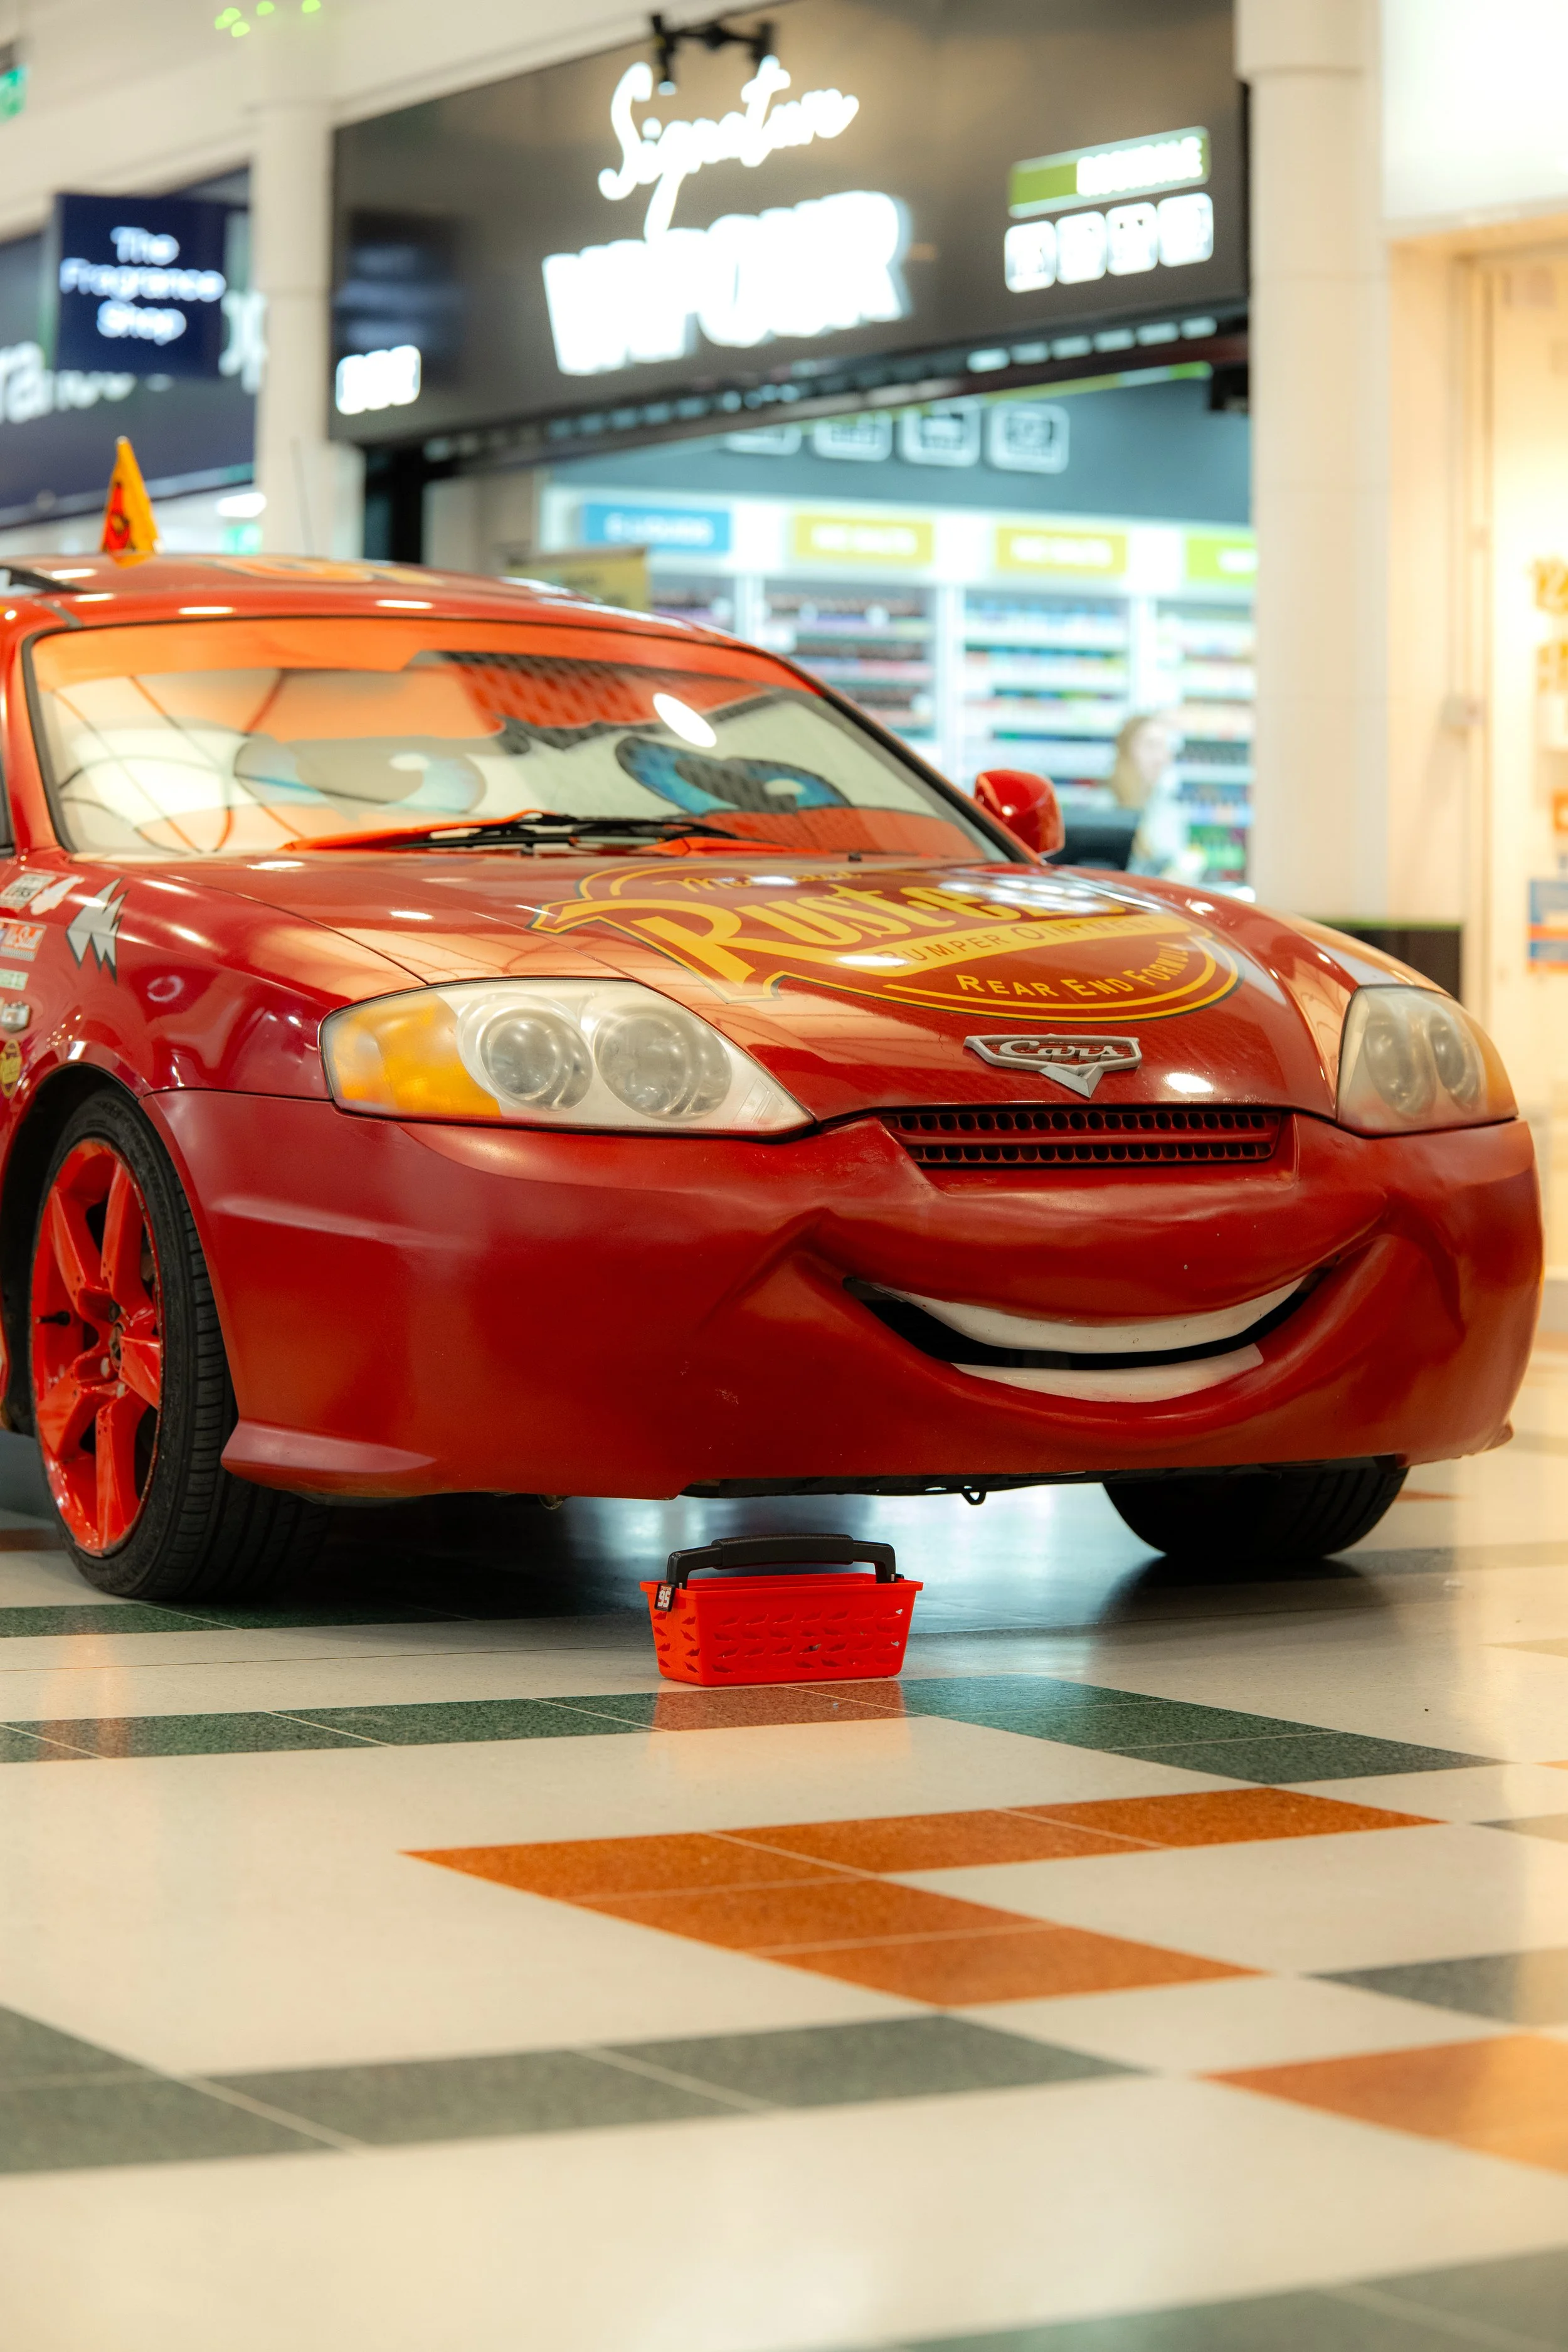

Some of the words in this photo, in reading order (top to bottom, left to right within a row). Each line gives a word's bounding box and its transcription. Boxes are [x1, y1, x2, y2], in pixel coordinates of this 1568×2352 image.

[110, 226, 180, 266] The
[97, 299, 187, 346] Shop
[874, 934, 1011, 968] BUMPER
[955, 974, 1060, 997] REAR
[1060, 978, 1135, 997] END
[999, 1040, 1125, 1062] Cars
[657, 1590, 672, 1608] 95
